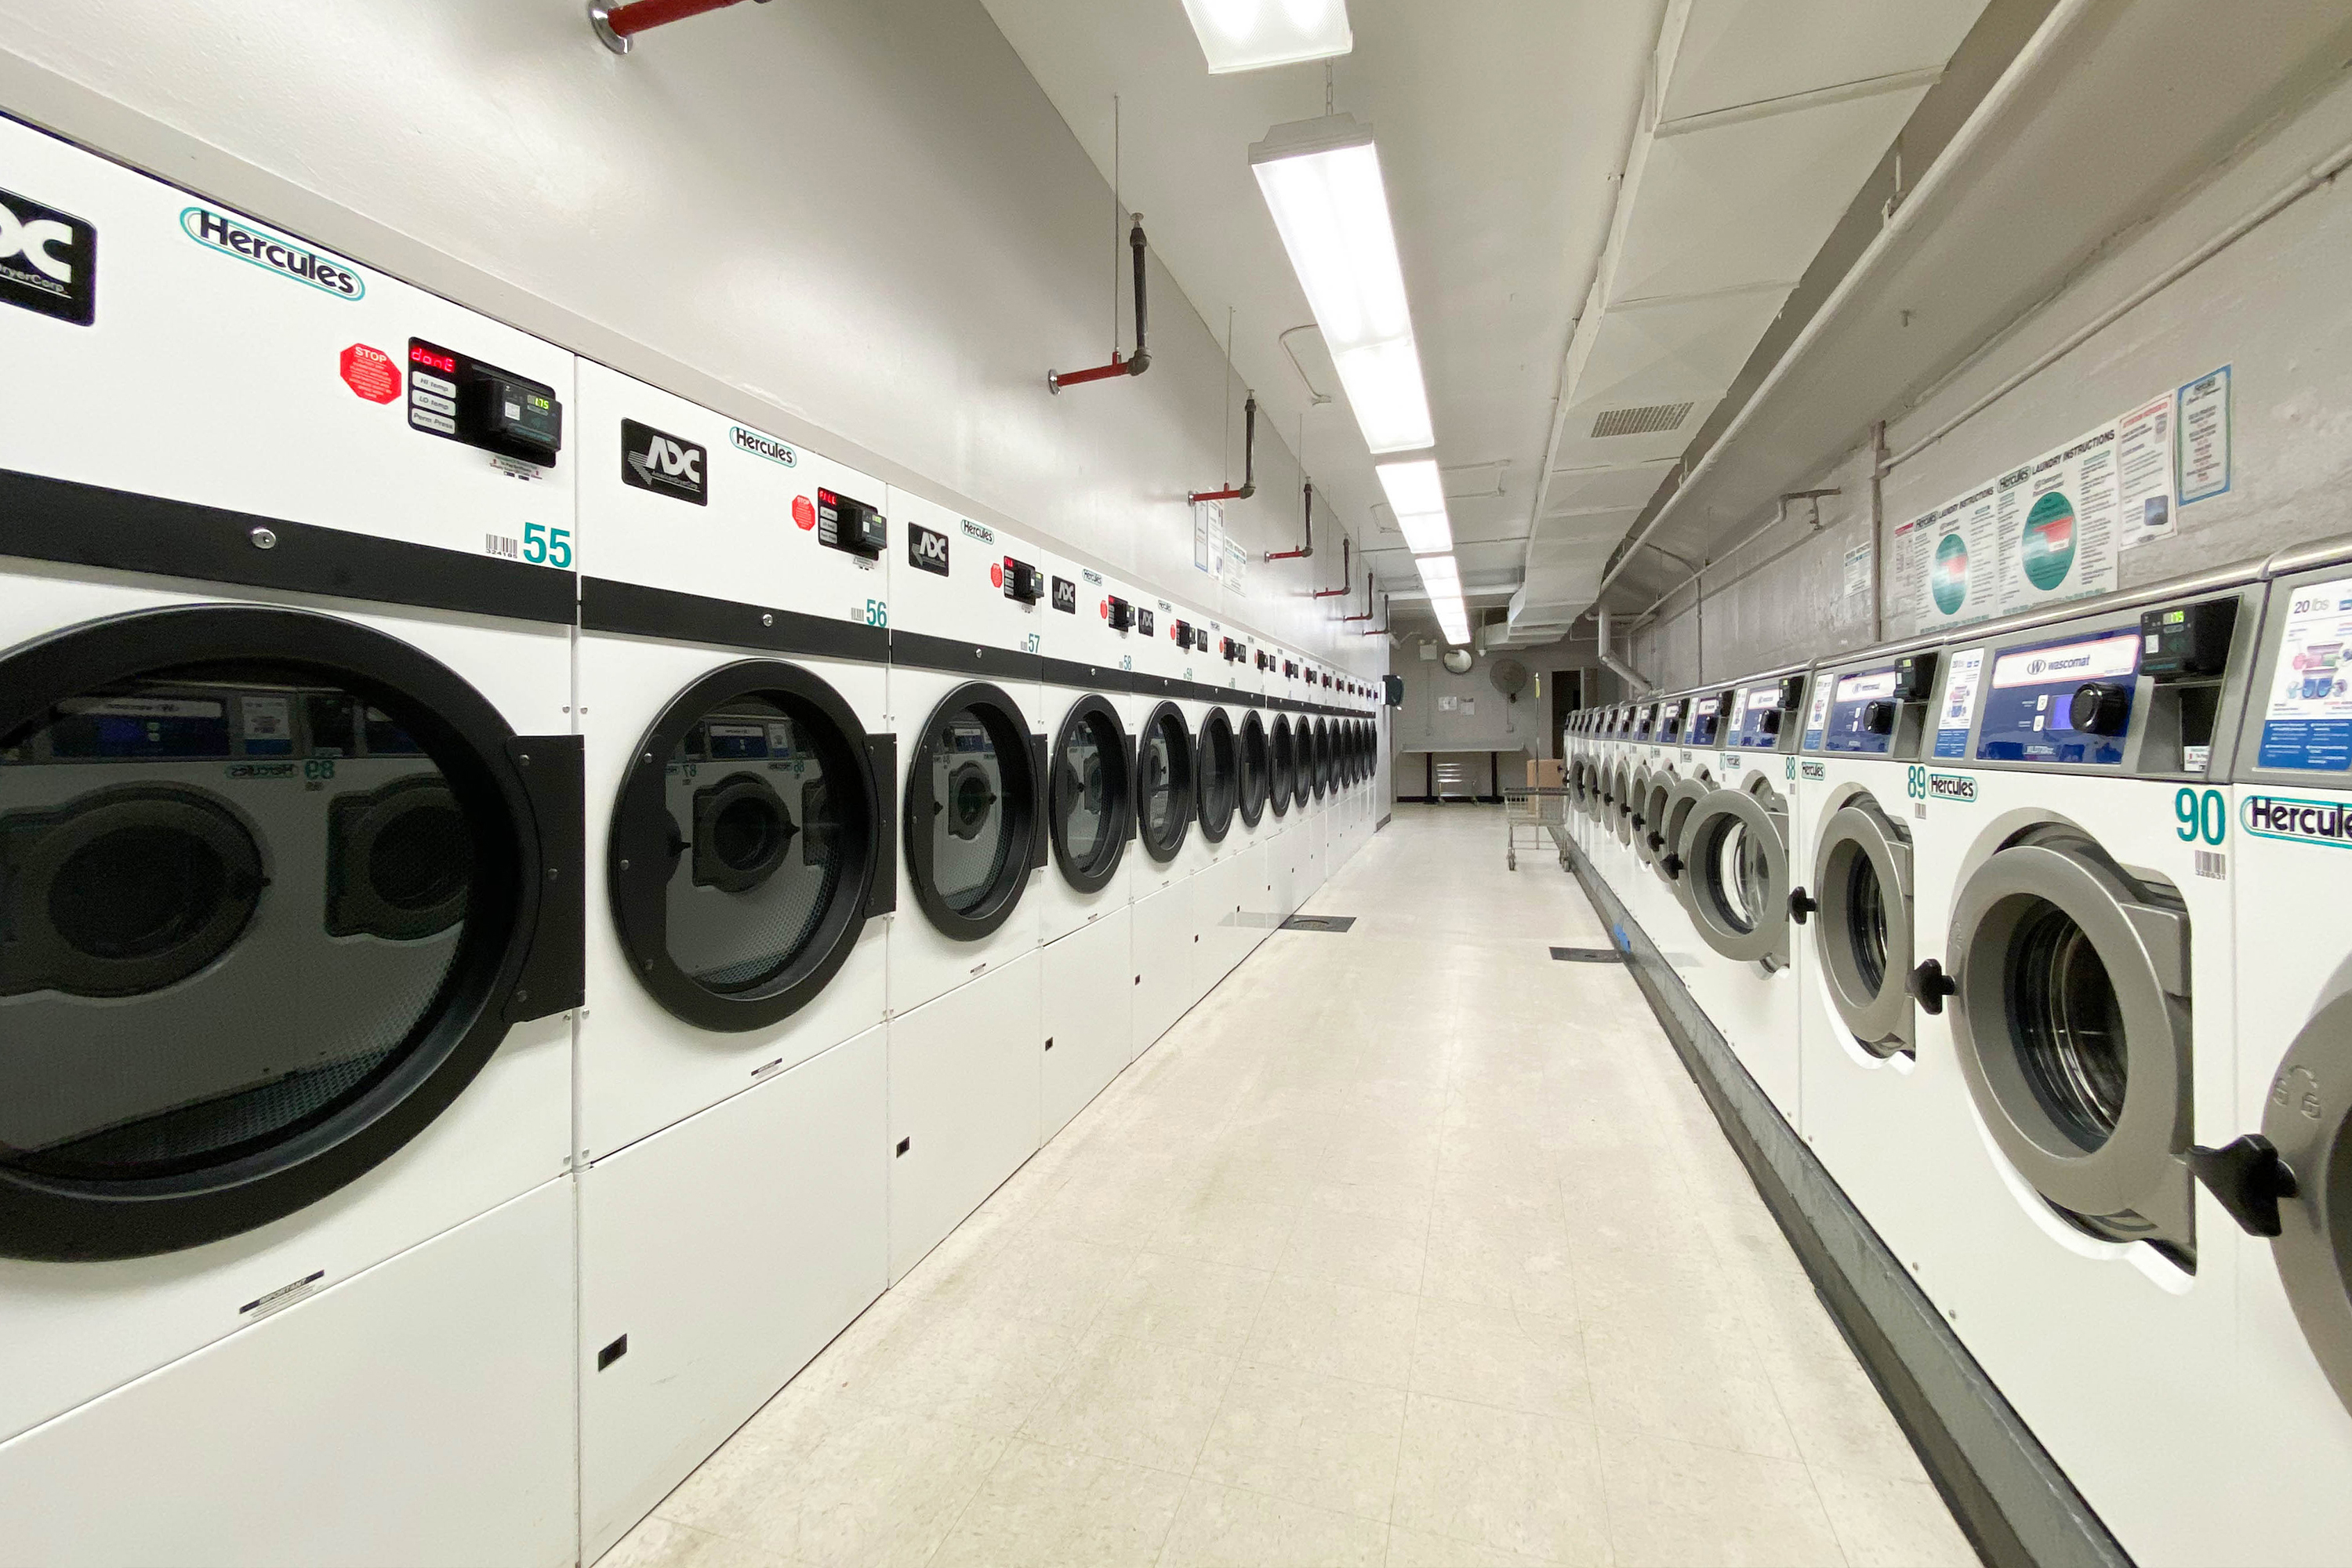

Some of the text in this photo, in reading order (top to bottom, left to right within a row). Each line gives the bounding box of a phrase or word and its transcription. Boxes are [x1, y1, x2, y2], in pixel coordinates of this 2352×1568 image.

[201, 210, 354, 293] Hercules
[355, 347, 387, 362] STOP
[736, 427, 793, 463] Hercules
[2032, 454, 2062, 475] LAUNDRY
[2063, 430, 2114, 462] INSTRUCTIONS
[645, 435, 700, 484] ADC
[964, 520, 993, 542] Hercules
[523, 522, 572, 568] 55
[919, 532, 946, 562] ADC
[866, 599, 887, 628] 56
[2294, 600, 2310, 614] 20
[1029, 633, 1040, 653] 57
[1123, 655, 1131, 670] 58
[2048, 655, 2091, 670] wascomat
[1786, 757, 1795, 780] 88
[1802, 762, 1824, 777] Hercules
[1908, 765, 1926, 800] 89
[1931, 775, 1973, 797] Hercules
[2176, 788, 2226, 846] 90
